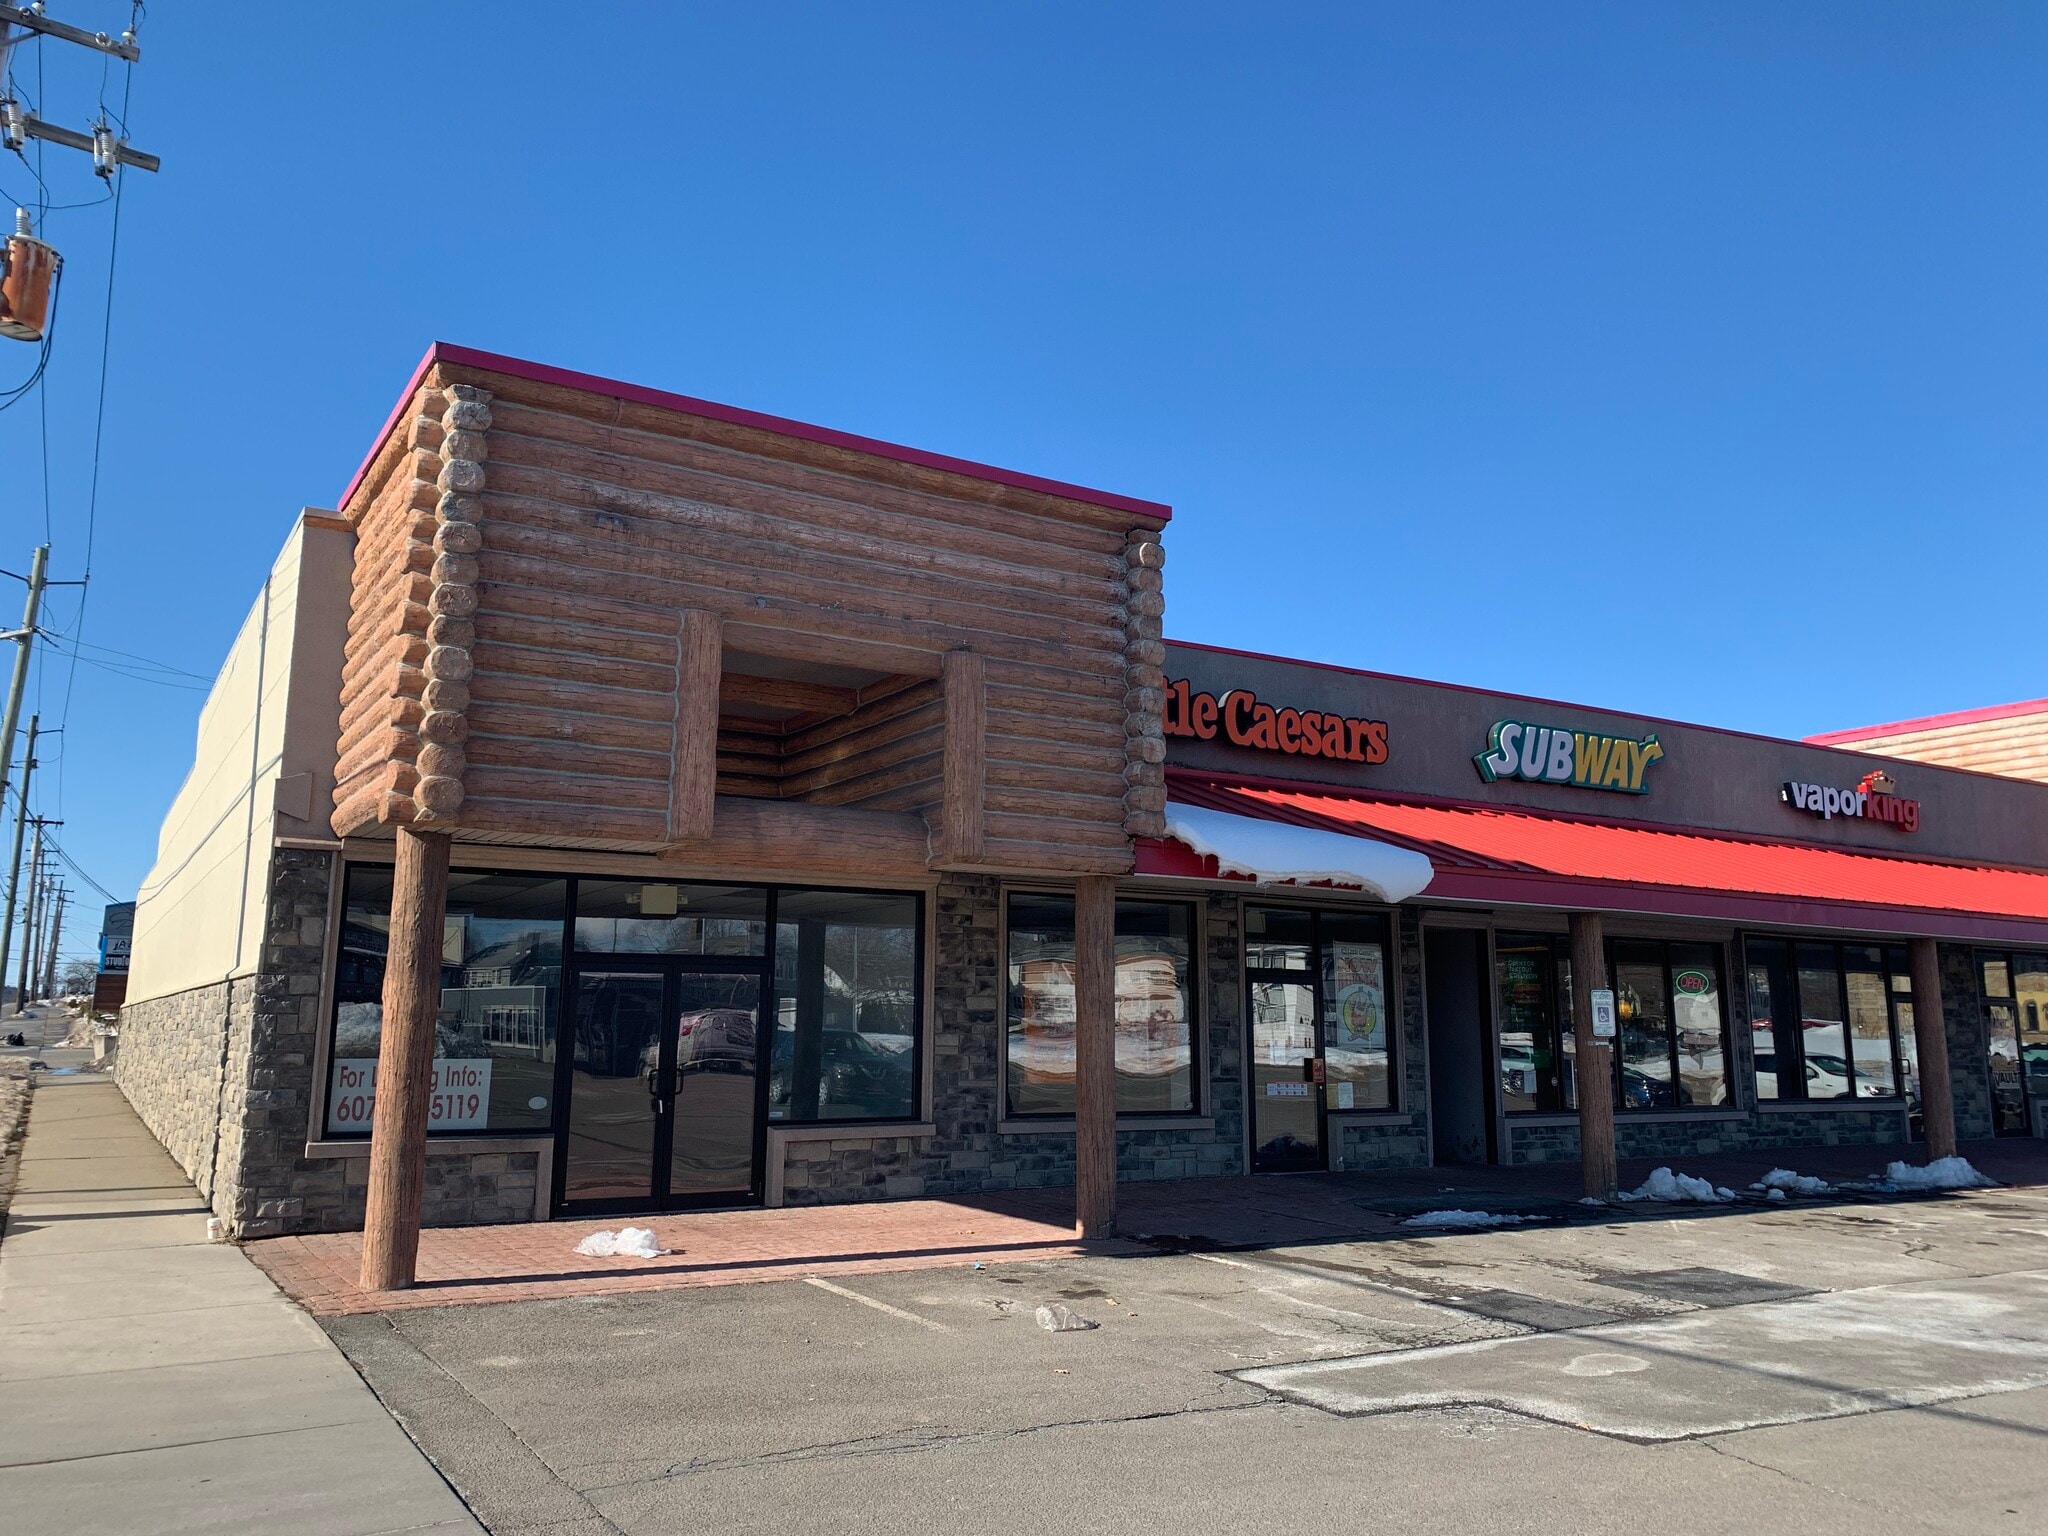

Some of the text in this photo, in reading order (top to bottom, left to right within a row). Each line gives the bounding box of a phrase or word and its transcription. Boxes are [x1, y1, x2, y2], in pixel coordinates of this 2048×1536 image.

[1224, 689, 1389, 765] Caesars
[1486, 722, 1665, 791] SUBWAY
[1680, 976, 1705, 990] OPEN
[339, 1065, 366, 1088] For
[445, 1064, 483, 1088] Info:
